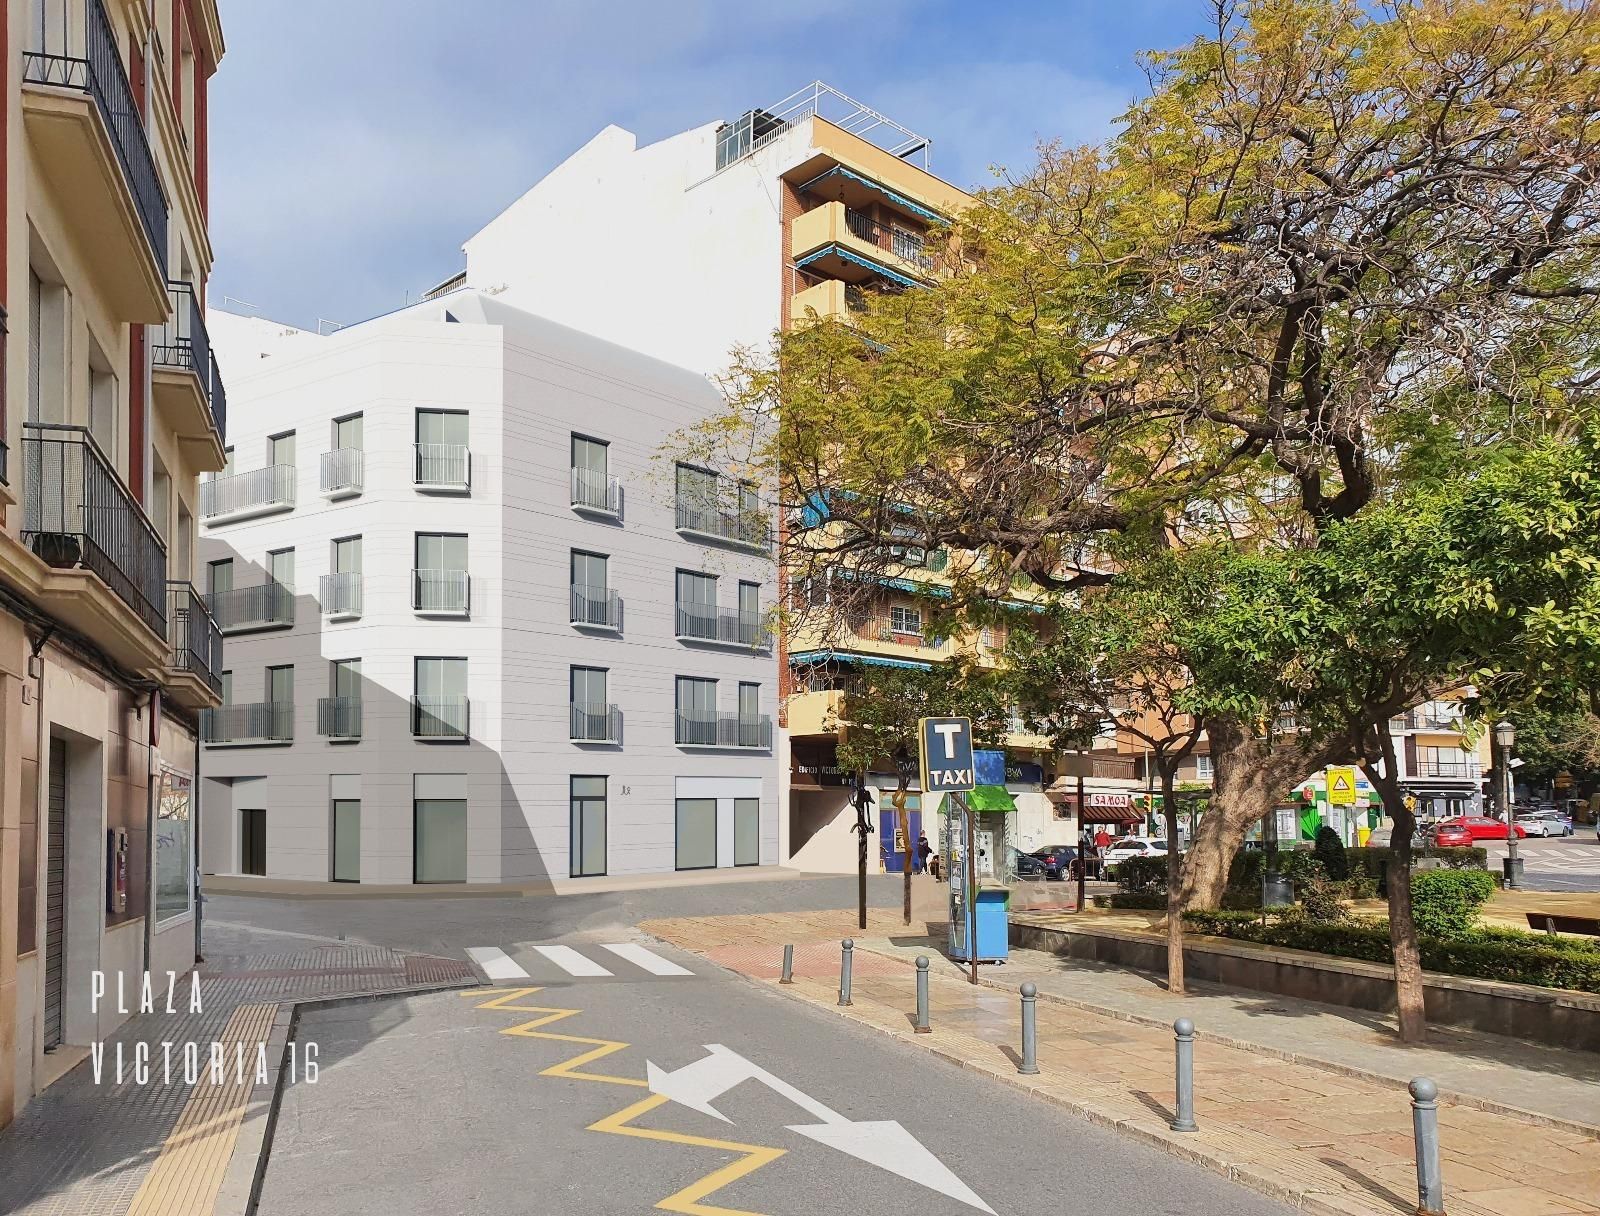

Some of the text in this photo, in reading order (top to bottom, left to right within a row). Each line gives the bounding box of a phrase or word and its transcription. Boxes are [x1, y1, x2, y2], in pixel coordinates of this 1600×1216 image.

[934, 723, 962, 759] T
[930, 769, 972, 785] TAXI
[1094, 795, 1126, 806] SAMOA
